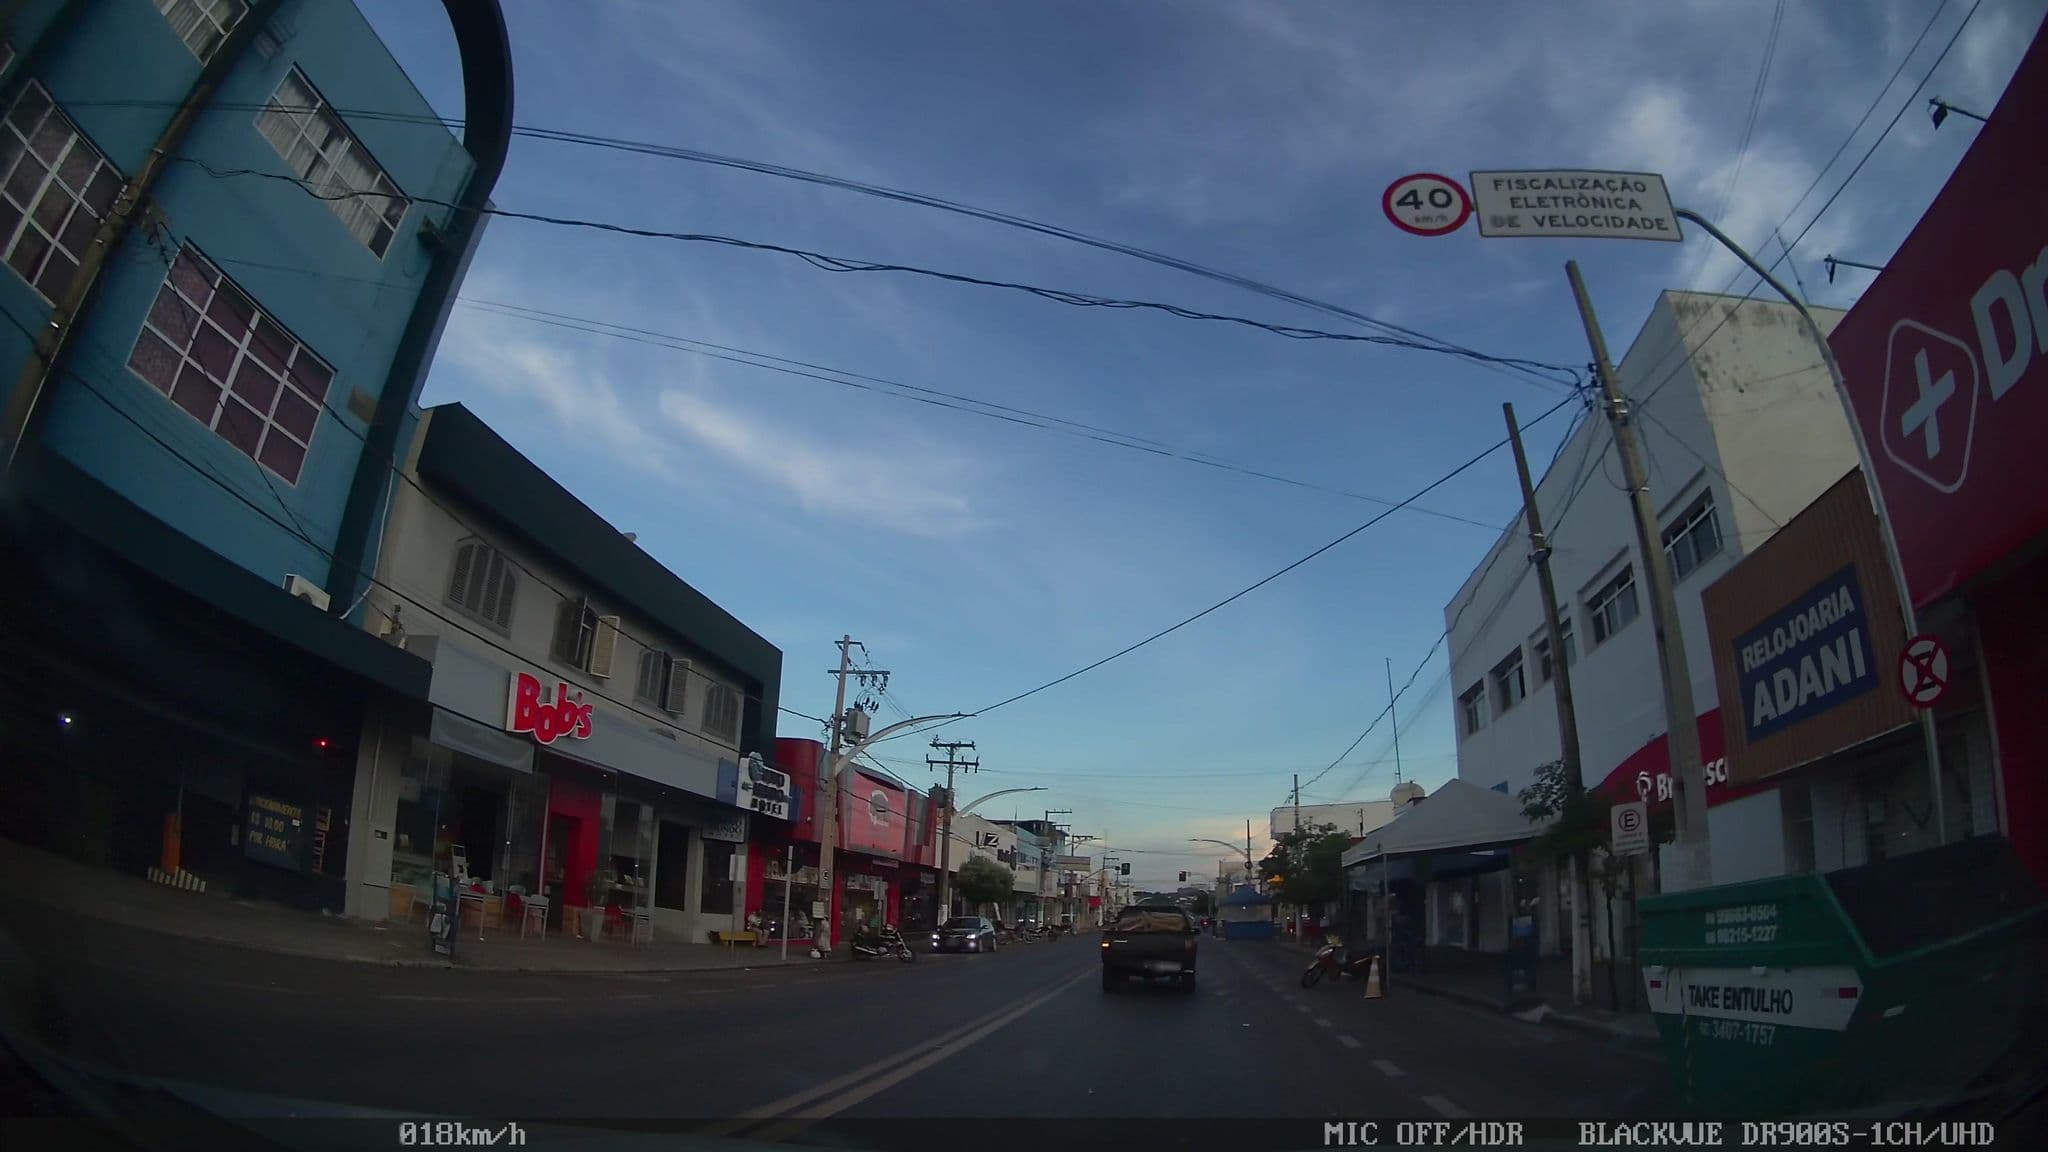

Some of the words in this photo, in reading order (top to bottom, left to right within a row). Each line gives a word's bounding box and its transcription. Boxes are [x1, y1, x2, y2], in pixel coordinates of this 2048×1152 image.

[1396, 187, 1453, 210] 40
[1493, 178, 1647, 194] FISCALIZAÇÃO
[1510, 194, 1642, 211] ELETRÔNICA
[1531, 215, 1669, 232] VELOCIDADE
[1742, 585, 1856, 673] RELOJOARIA
[1753, 627, 1866, 728] ADANI
[513, 671, 594, 744] Bob's
[1624, 813, 1635, 828] E
[1688, 985, 1719, 1008] TAKE
[1723, 987, 1793, 1014] ENTULHO
[1711, 1019, 1776, 1046] 3407-1757
